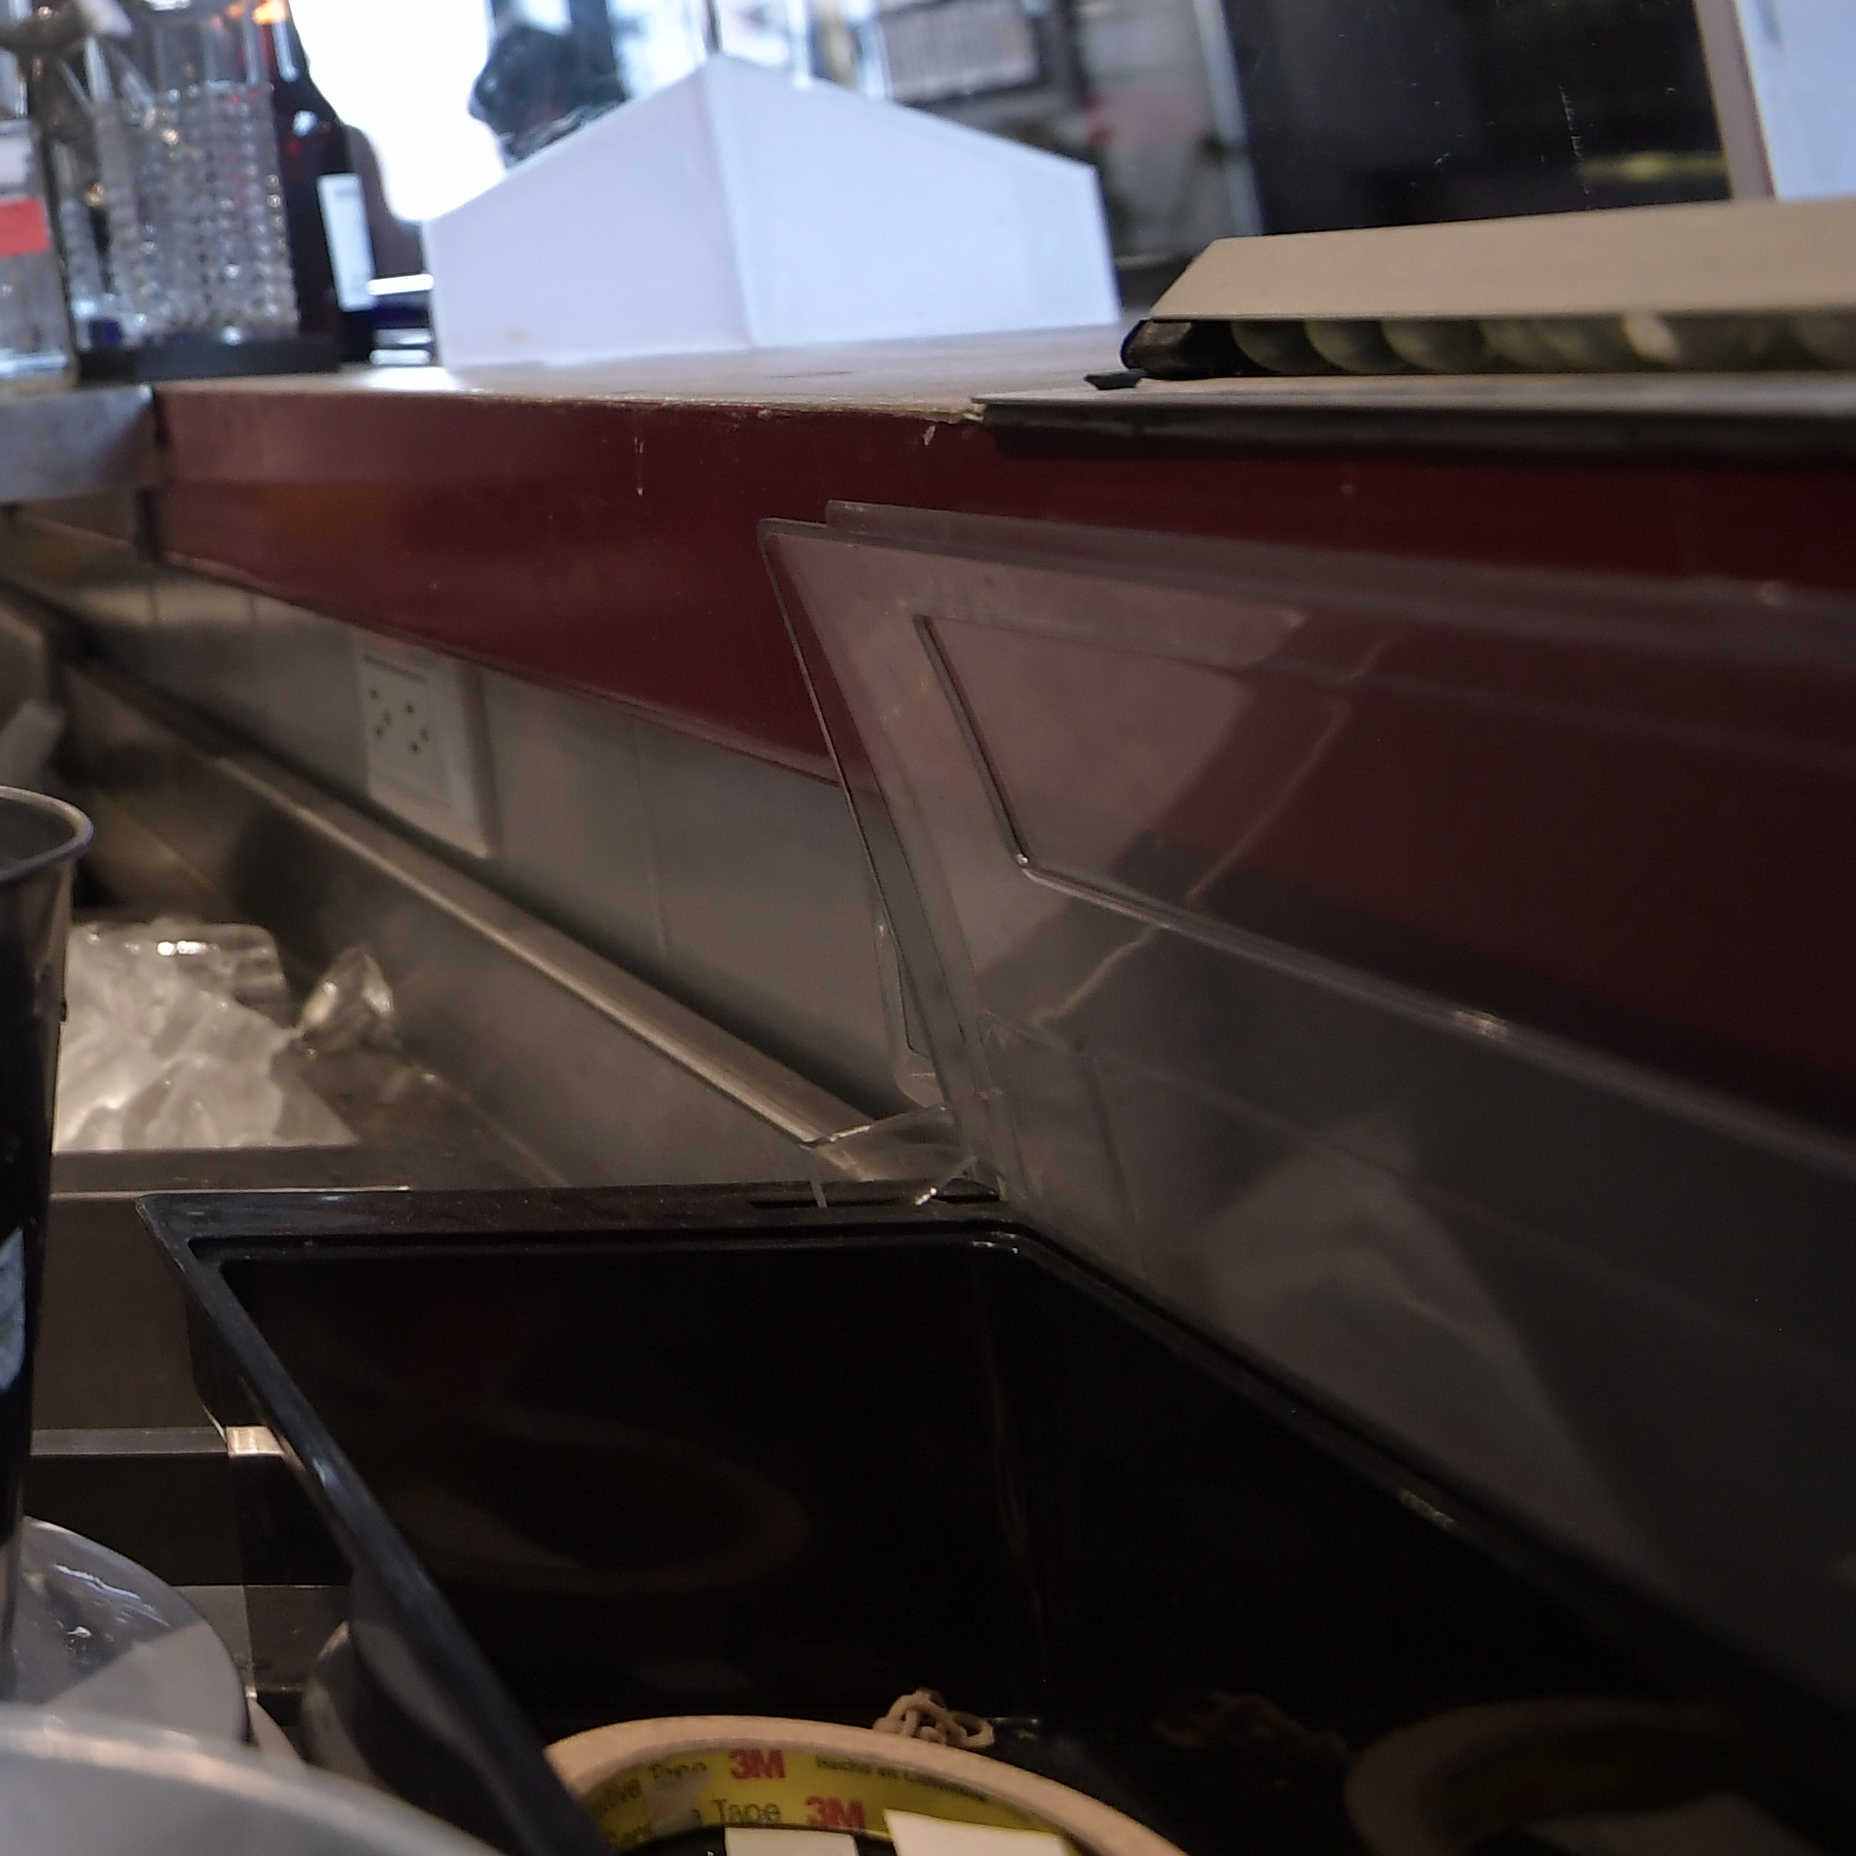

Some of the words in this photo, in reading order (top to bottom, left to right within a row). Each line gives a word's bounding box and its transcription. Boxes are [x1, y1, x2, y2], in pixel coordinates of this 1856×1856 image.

[728, 1748, 786, 1779] 3M
[712, 1798, 781, 1823] Tape
[805, 1795, 867, 1829] 3M
